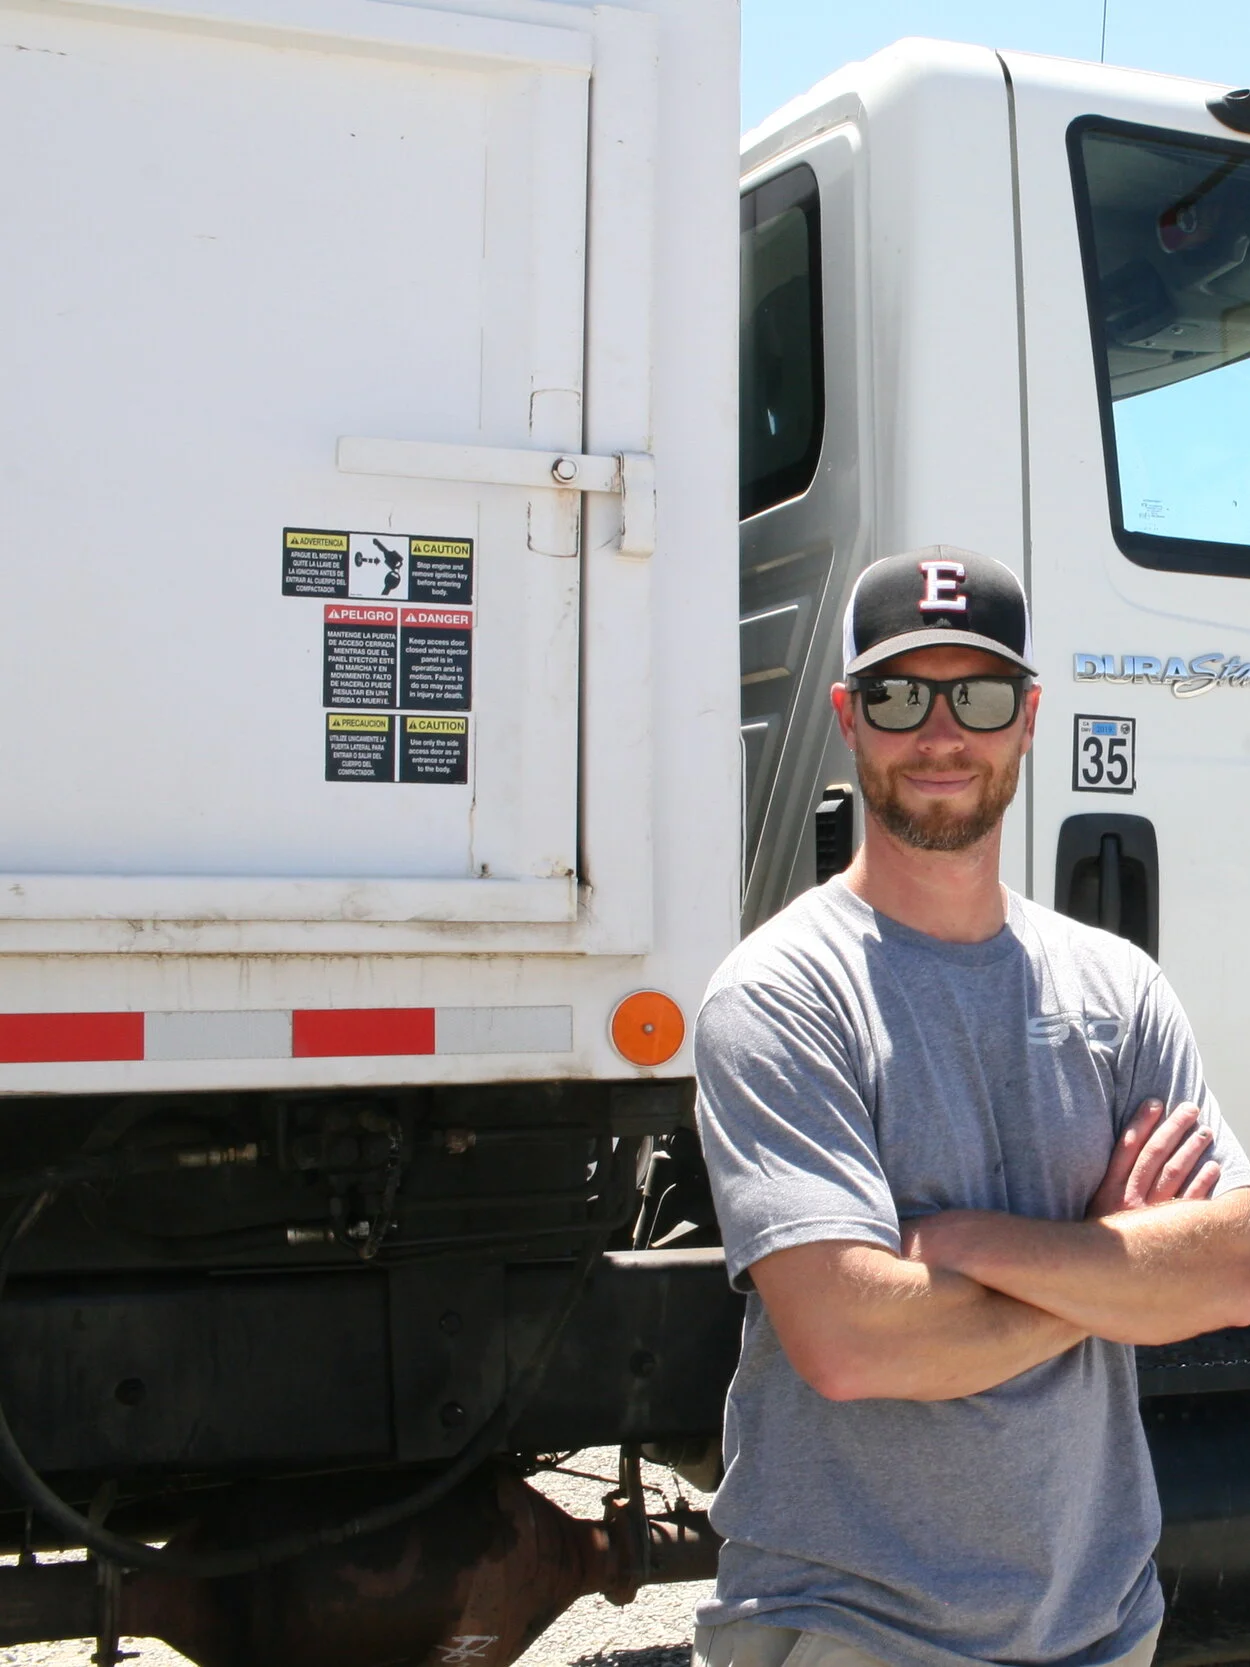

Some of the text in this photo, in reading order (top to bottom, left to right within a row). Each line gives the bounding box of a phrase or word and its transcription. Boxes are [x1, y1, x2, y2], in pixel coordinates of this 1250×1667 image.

[299, 538, 343, 547] ADVERTENCIA
[423, 544, 468, 554] CAUTION
[437, 580, 461, 589] entering
[918, 560, 968, 612] E
[341, 610, 393, 621] PELIGRO
[419, 613, 468, 624] DANGER
[447, 648, 468, 656] ejector
[417, 691, 434, 699] injury
[342, 719, 386, 727] PRECAUCION
[419, 721, 464, 730] CAUTION
[1082, 736, 1128, 785] 35
